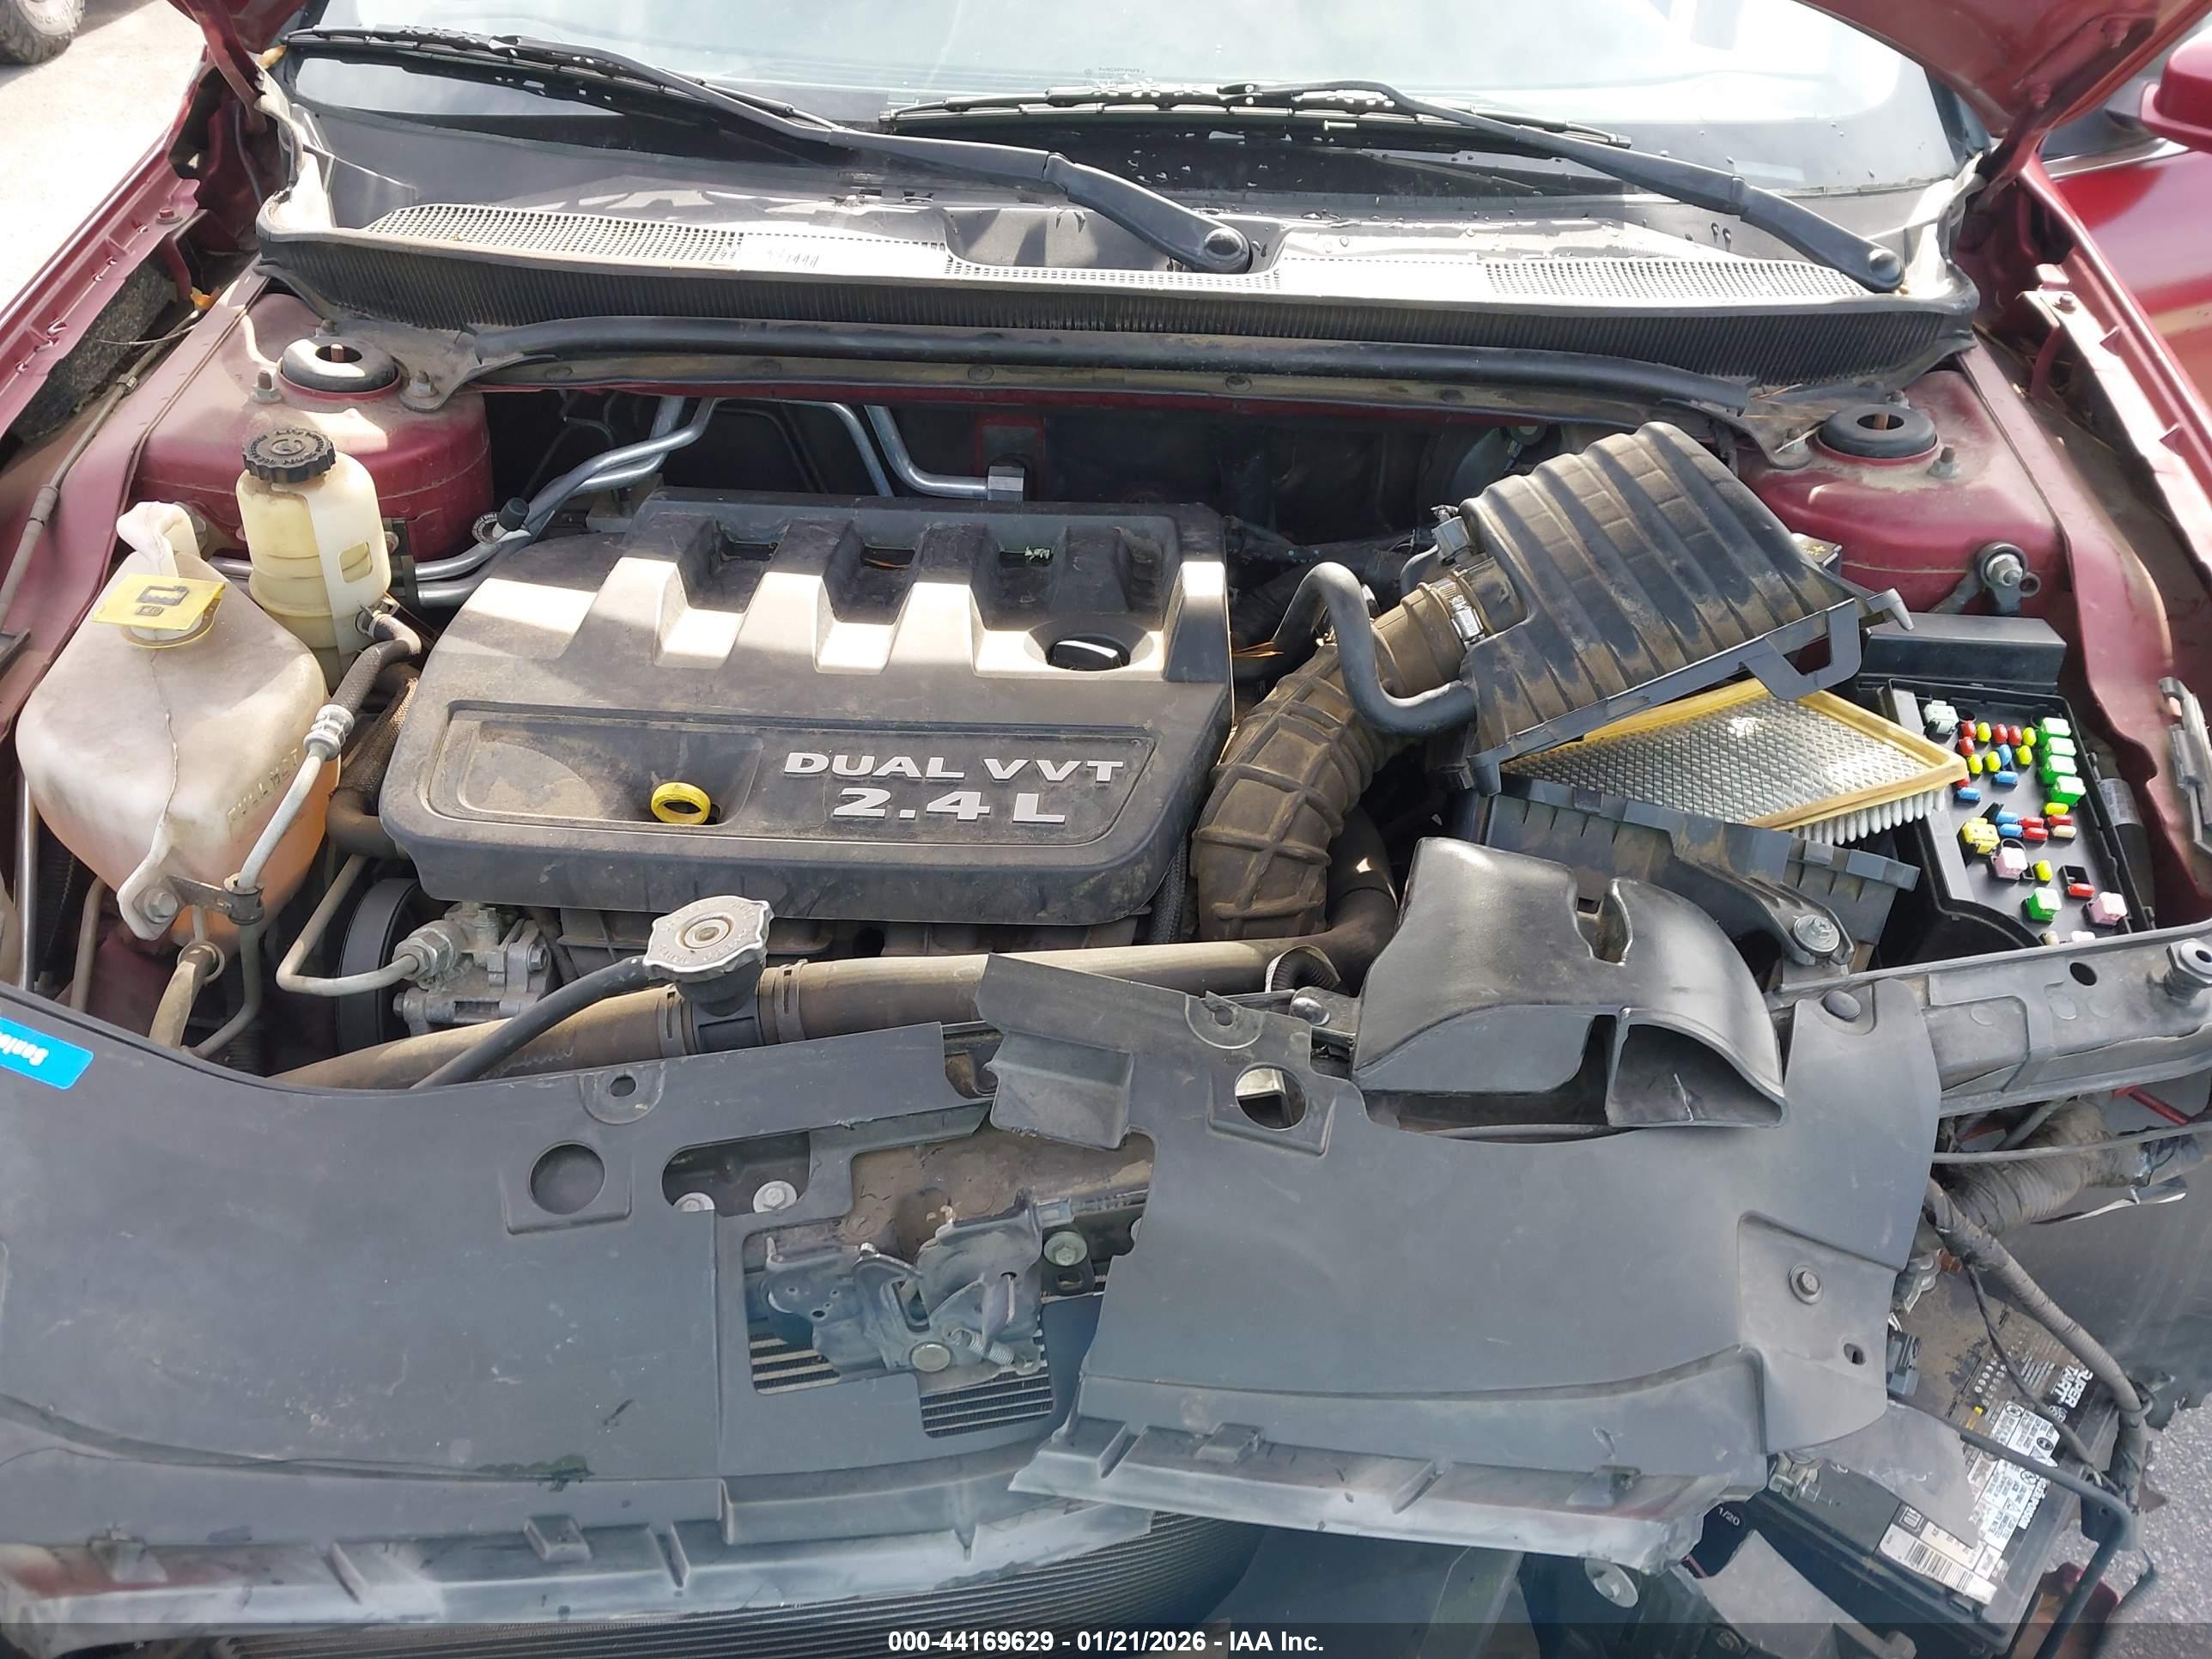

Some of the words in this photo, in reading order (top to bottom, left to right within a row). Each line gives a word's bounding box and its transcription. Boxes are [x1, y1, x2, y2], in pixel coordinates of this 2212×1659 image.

[783, 751, 966, 780] DUAL
[983, 757, 1125, 783] VVT
[832, 787, 992, 821] 2.4
[1012, 792, 1066, 823] L
